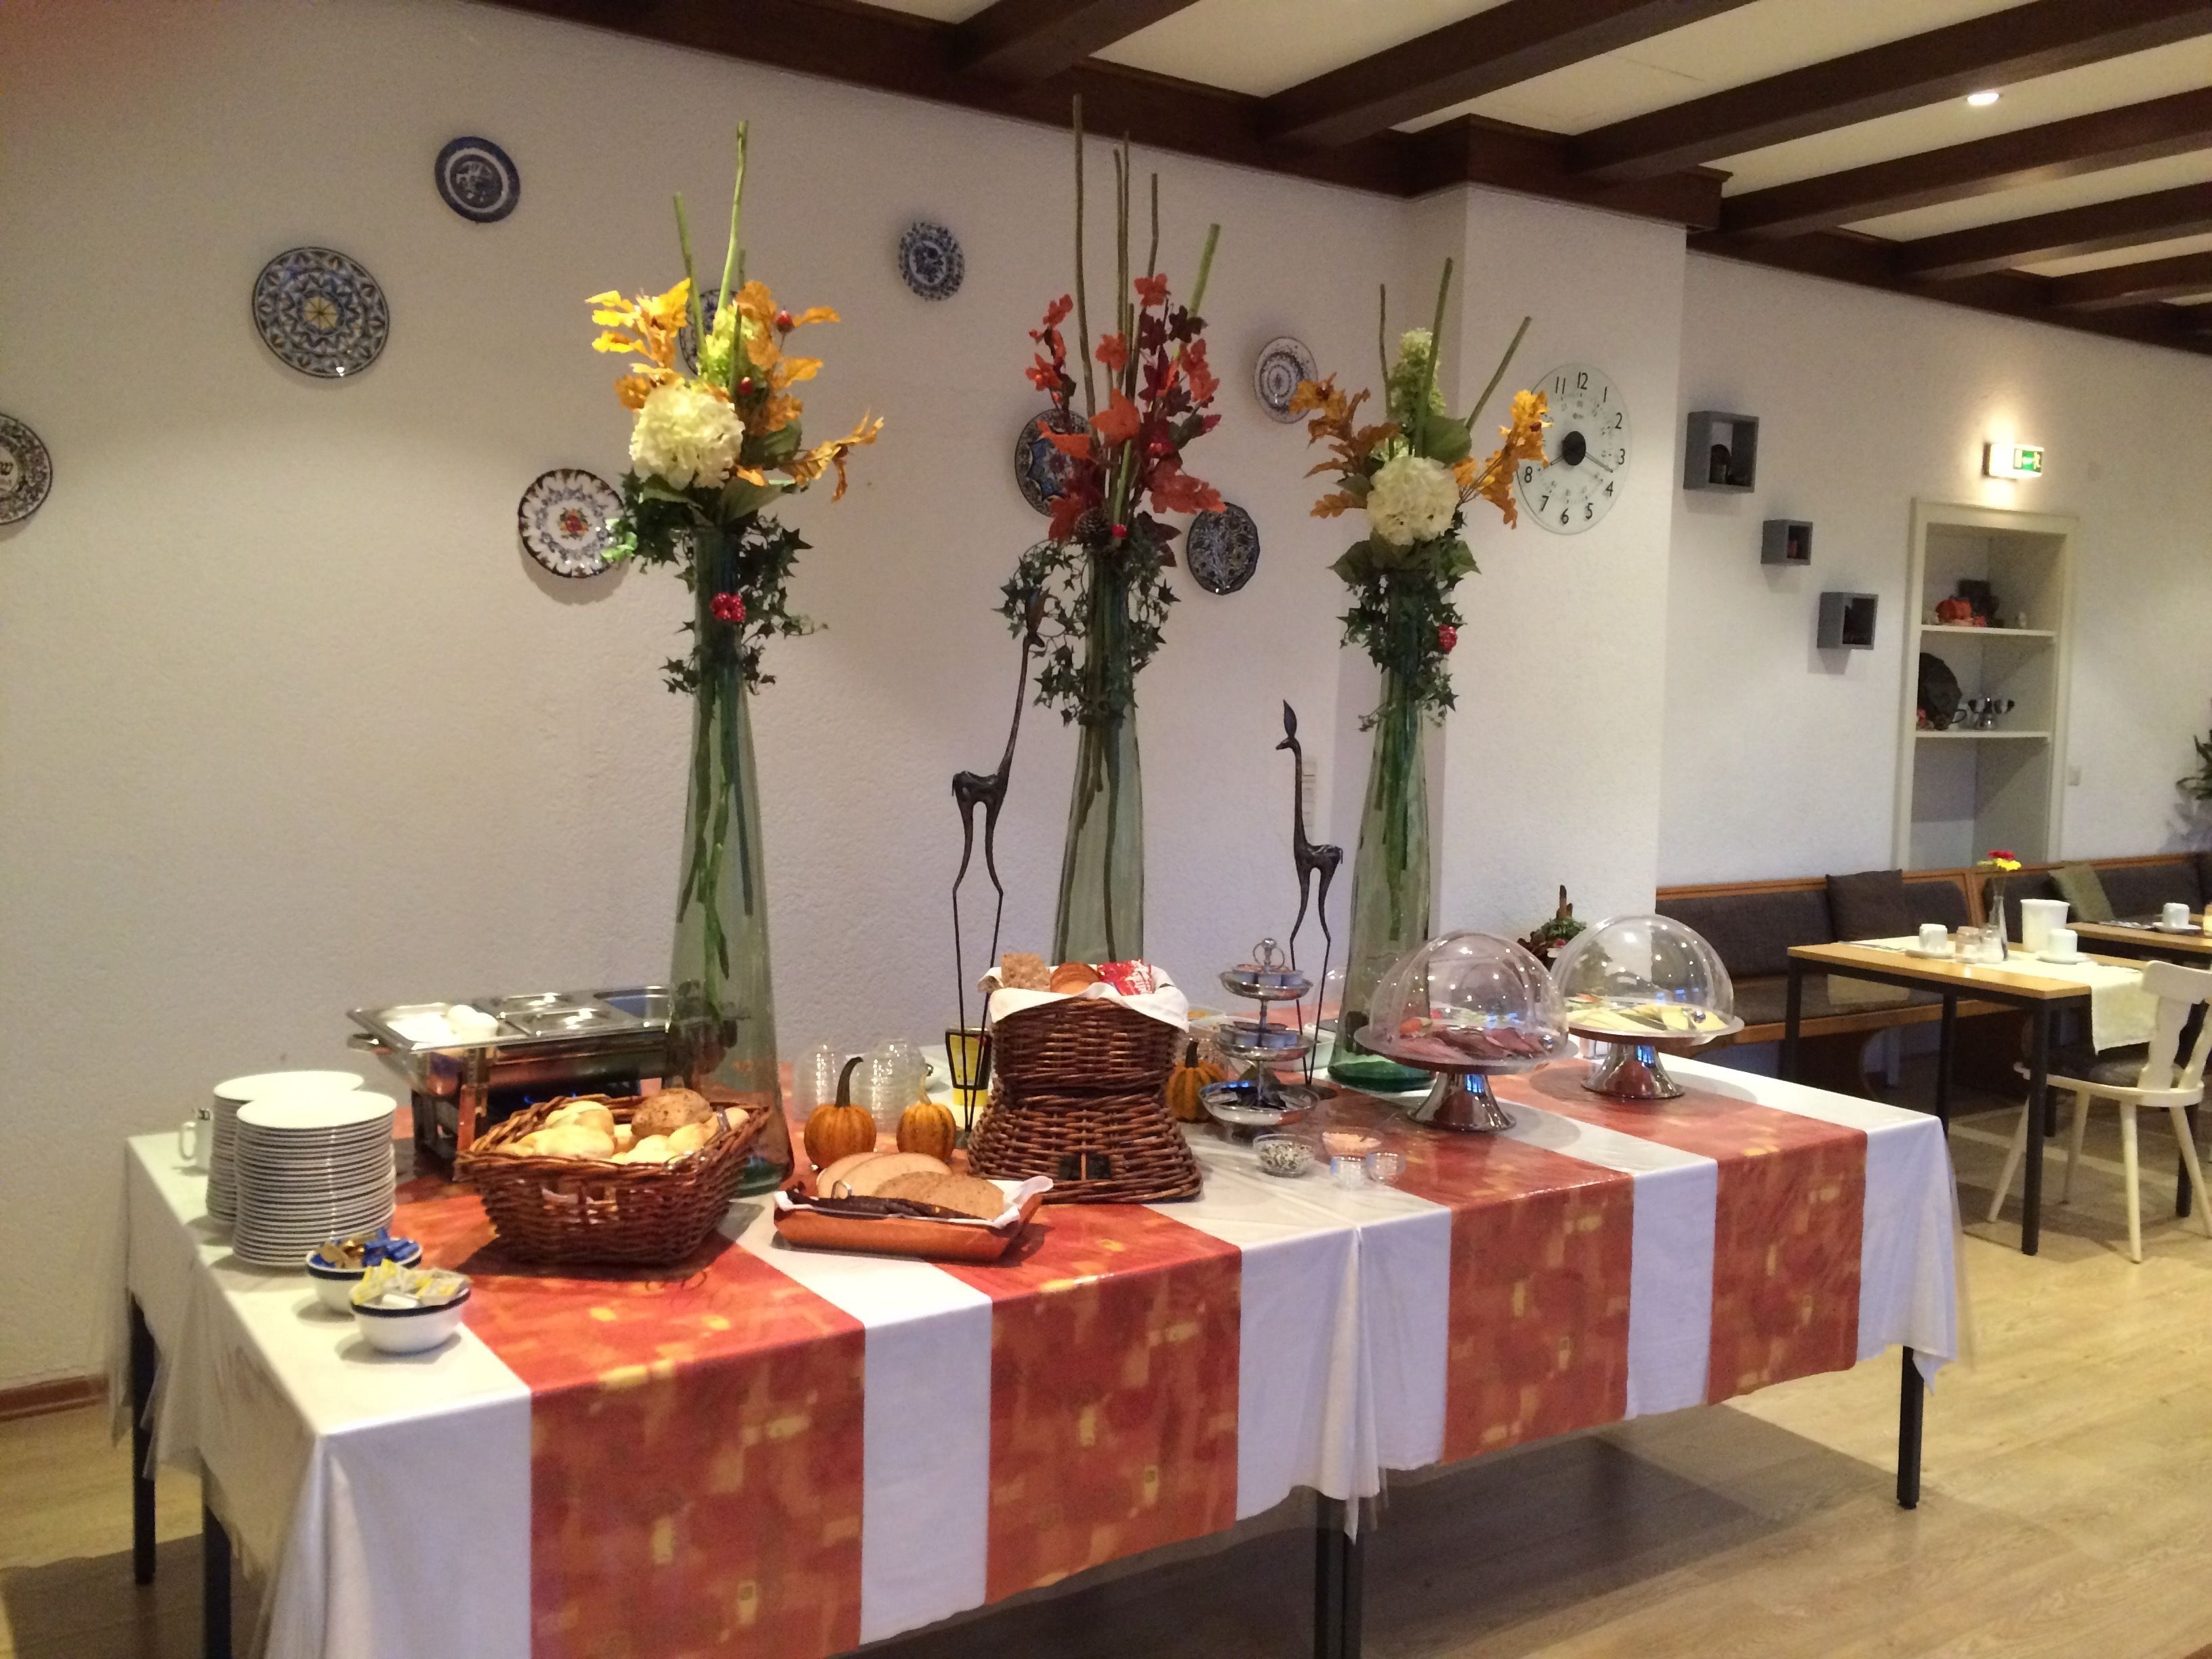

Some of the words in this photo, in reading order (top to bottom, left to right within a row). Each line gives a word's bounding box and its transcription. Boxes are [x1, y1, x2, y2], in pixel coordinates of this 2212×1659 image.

[1555, 376, 1566, 394] 11
[1577, 371, 1589, 390] 12
[1614, 411, 1622, 430] 2
[1618, 448, 1626, 465] 3
[1524, 466, 1533, 483] 8
[1605, 480, 1614, 497] 4
[1540, 495, 1549, 512] 7
[1585, 502, 1593, 520] 5
[1561, 508, 1569, 525] 6
